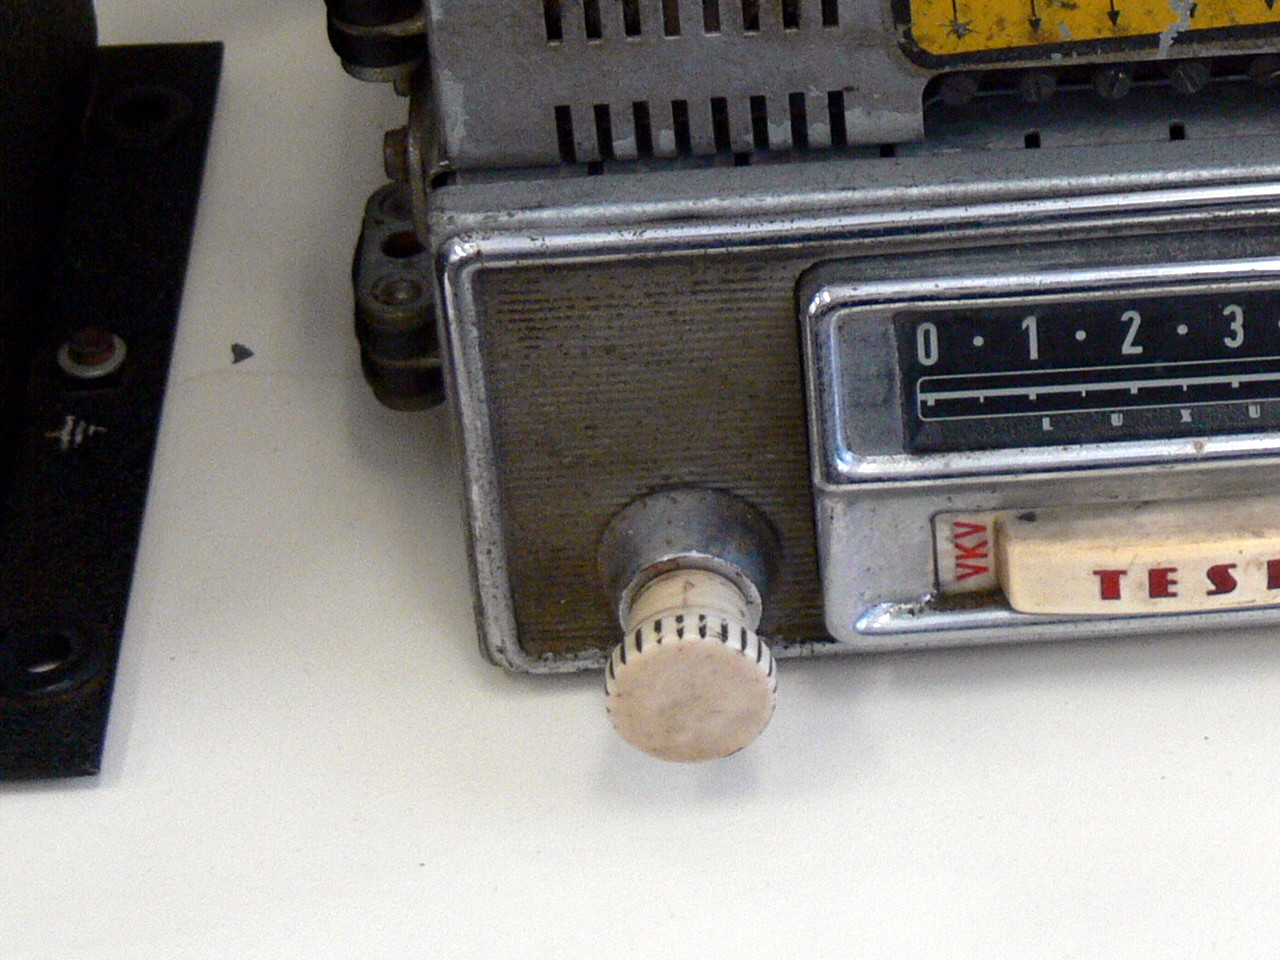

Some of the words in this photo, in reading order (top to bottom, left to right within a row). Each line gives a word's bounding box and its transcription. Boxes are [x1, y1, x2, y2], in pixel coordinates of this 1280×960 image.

[917, 323, 939, 366] 0
[1022, 316, 1039, 360] 1
[1121, 310, 1143, 355] 2
[1223, 303, 1244, 348] 3
[953, 520, 989, 581] VKV
